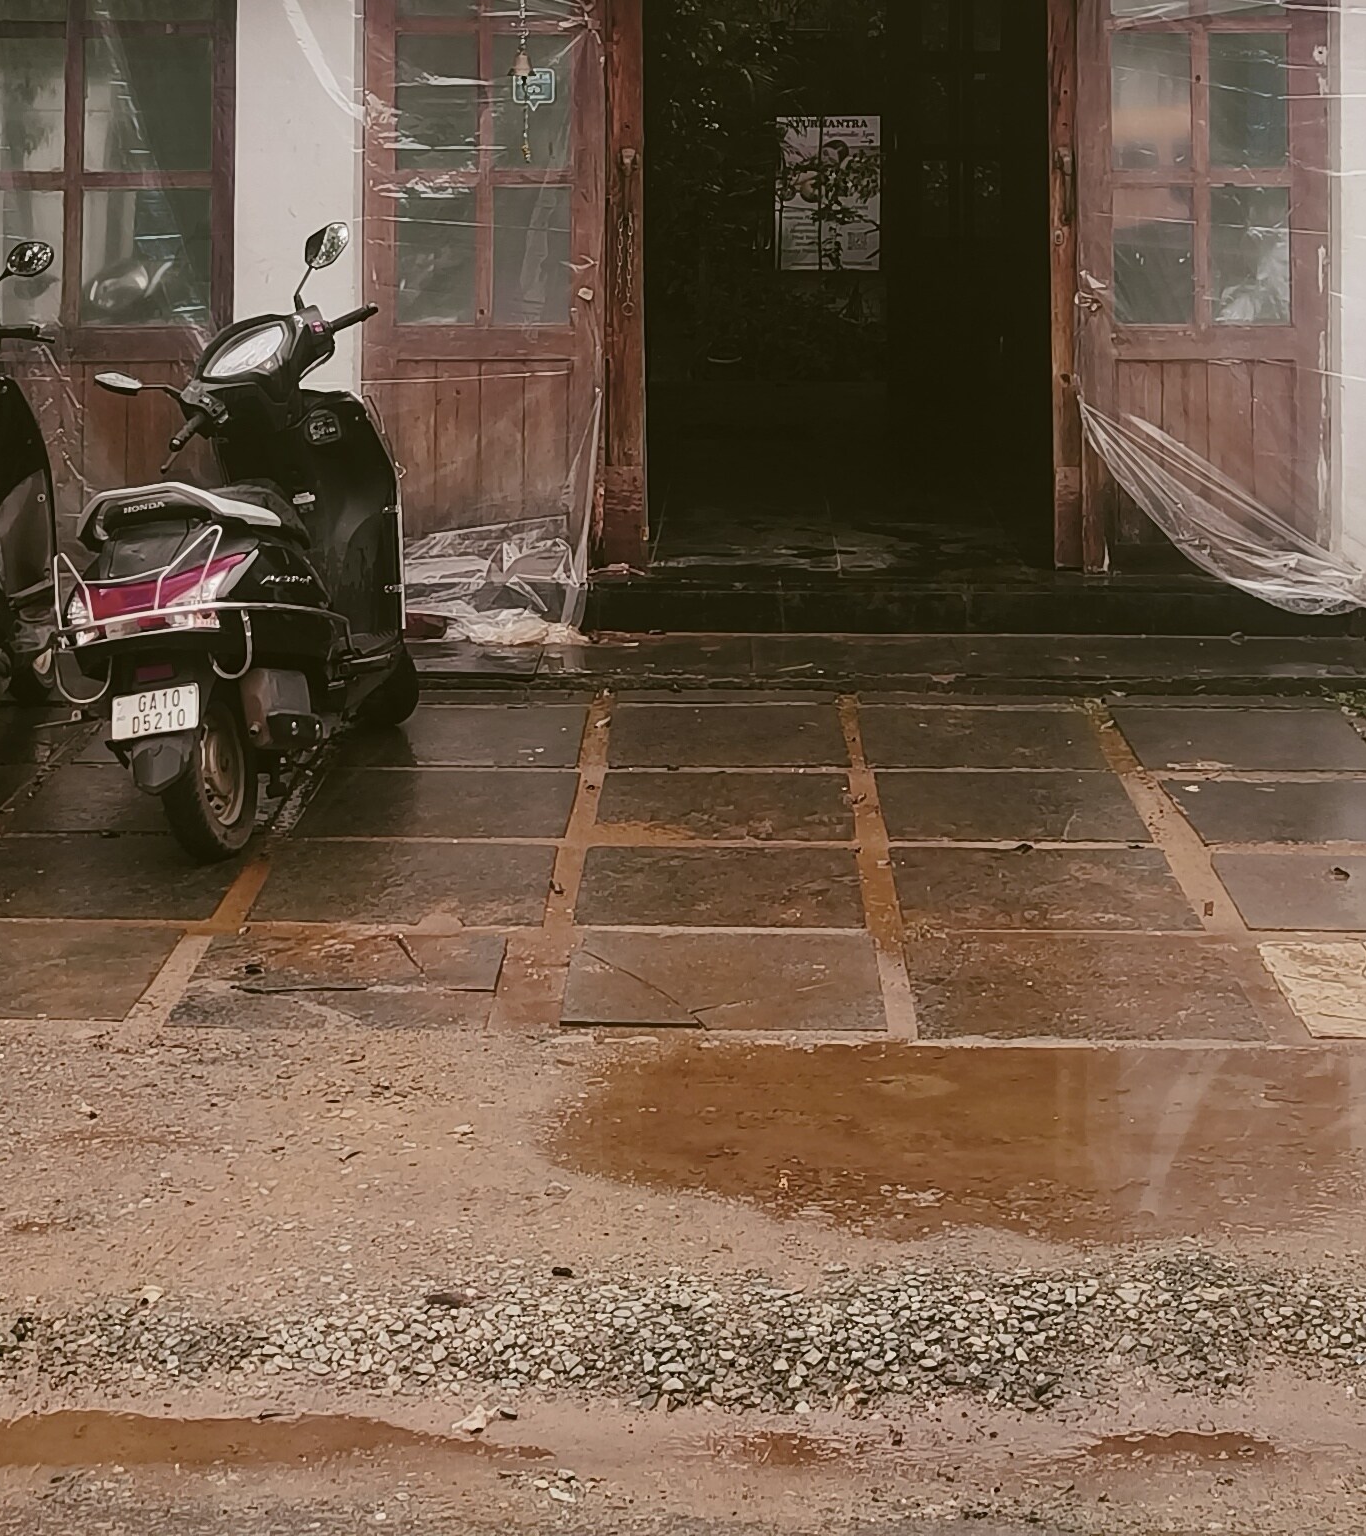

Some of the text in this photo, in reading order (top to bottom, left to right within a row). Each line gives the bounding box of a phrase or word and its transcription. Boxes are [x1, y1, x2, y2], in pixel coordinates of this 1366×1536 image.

[122, 501, 165, 514] HONDA
[138, 689, 181, 713] GA10
[132, 708, 186, 735] D5210
